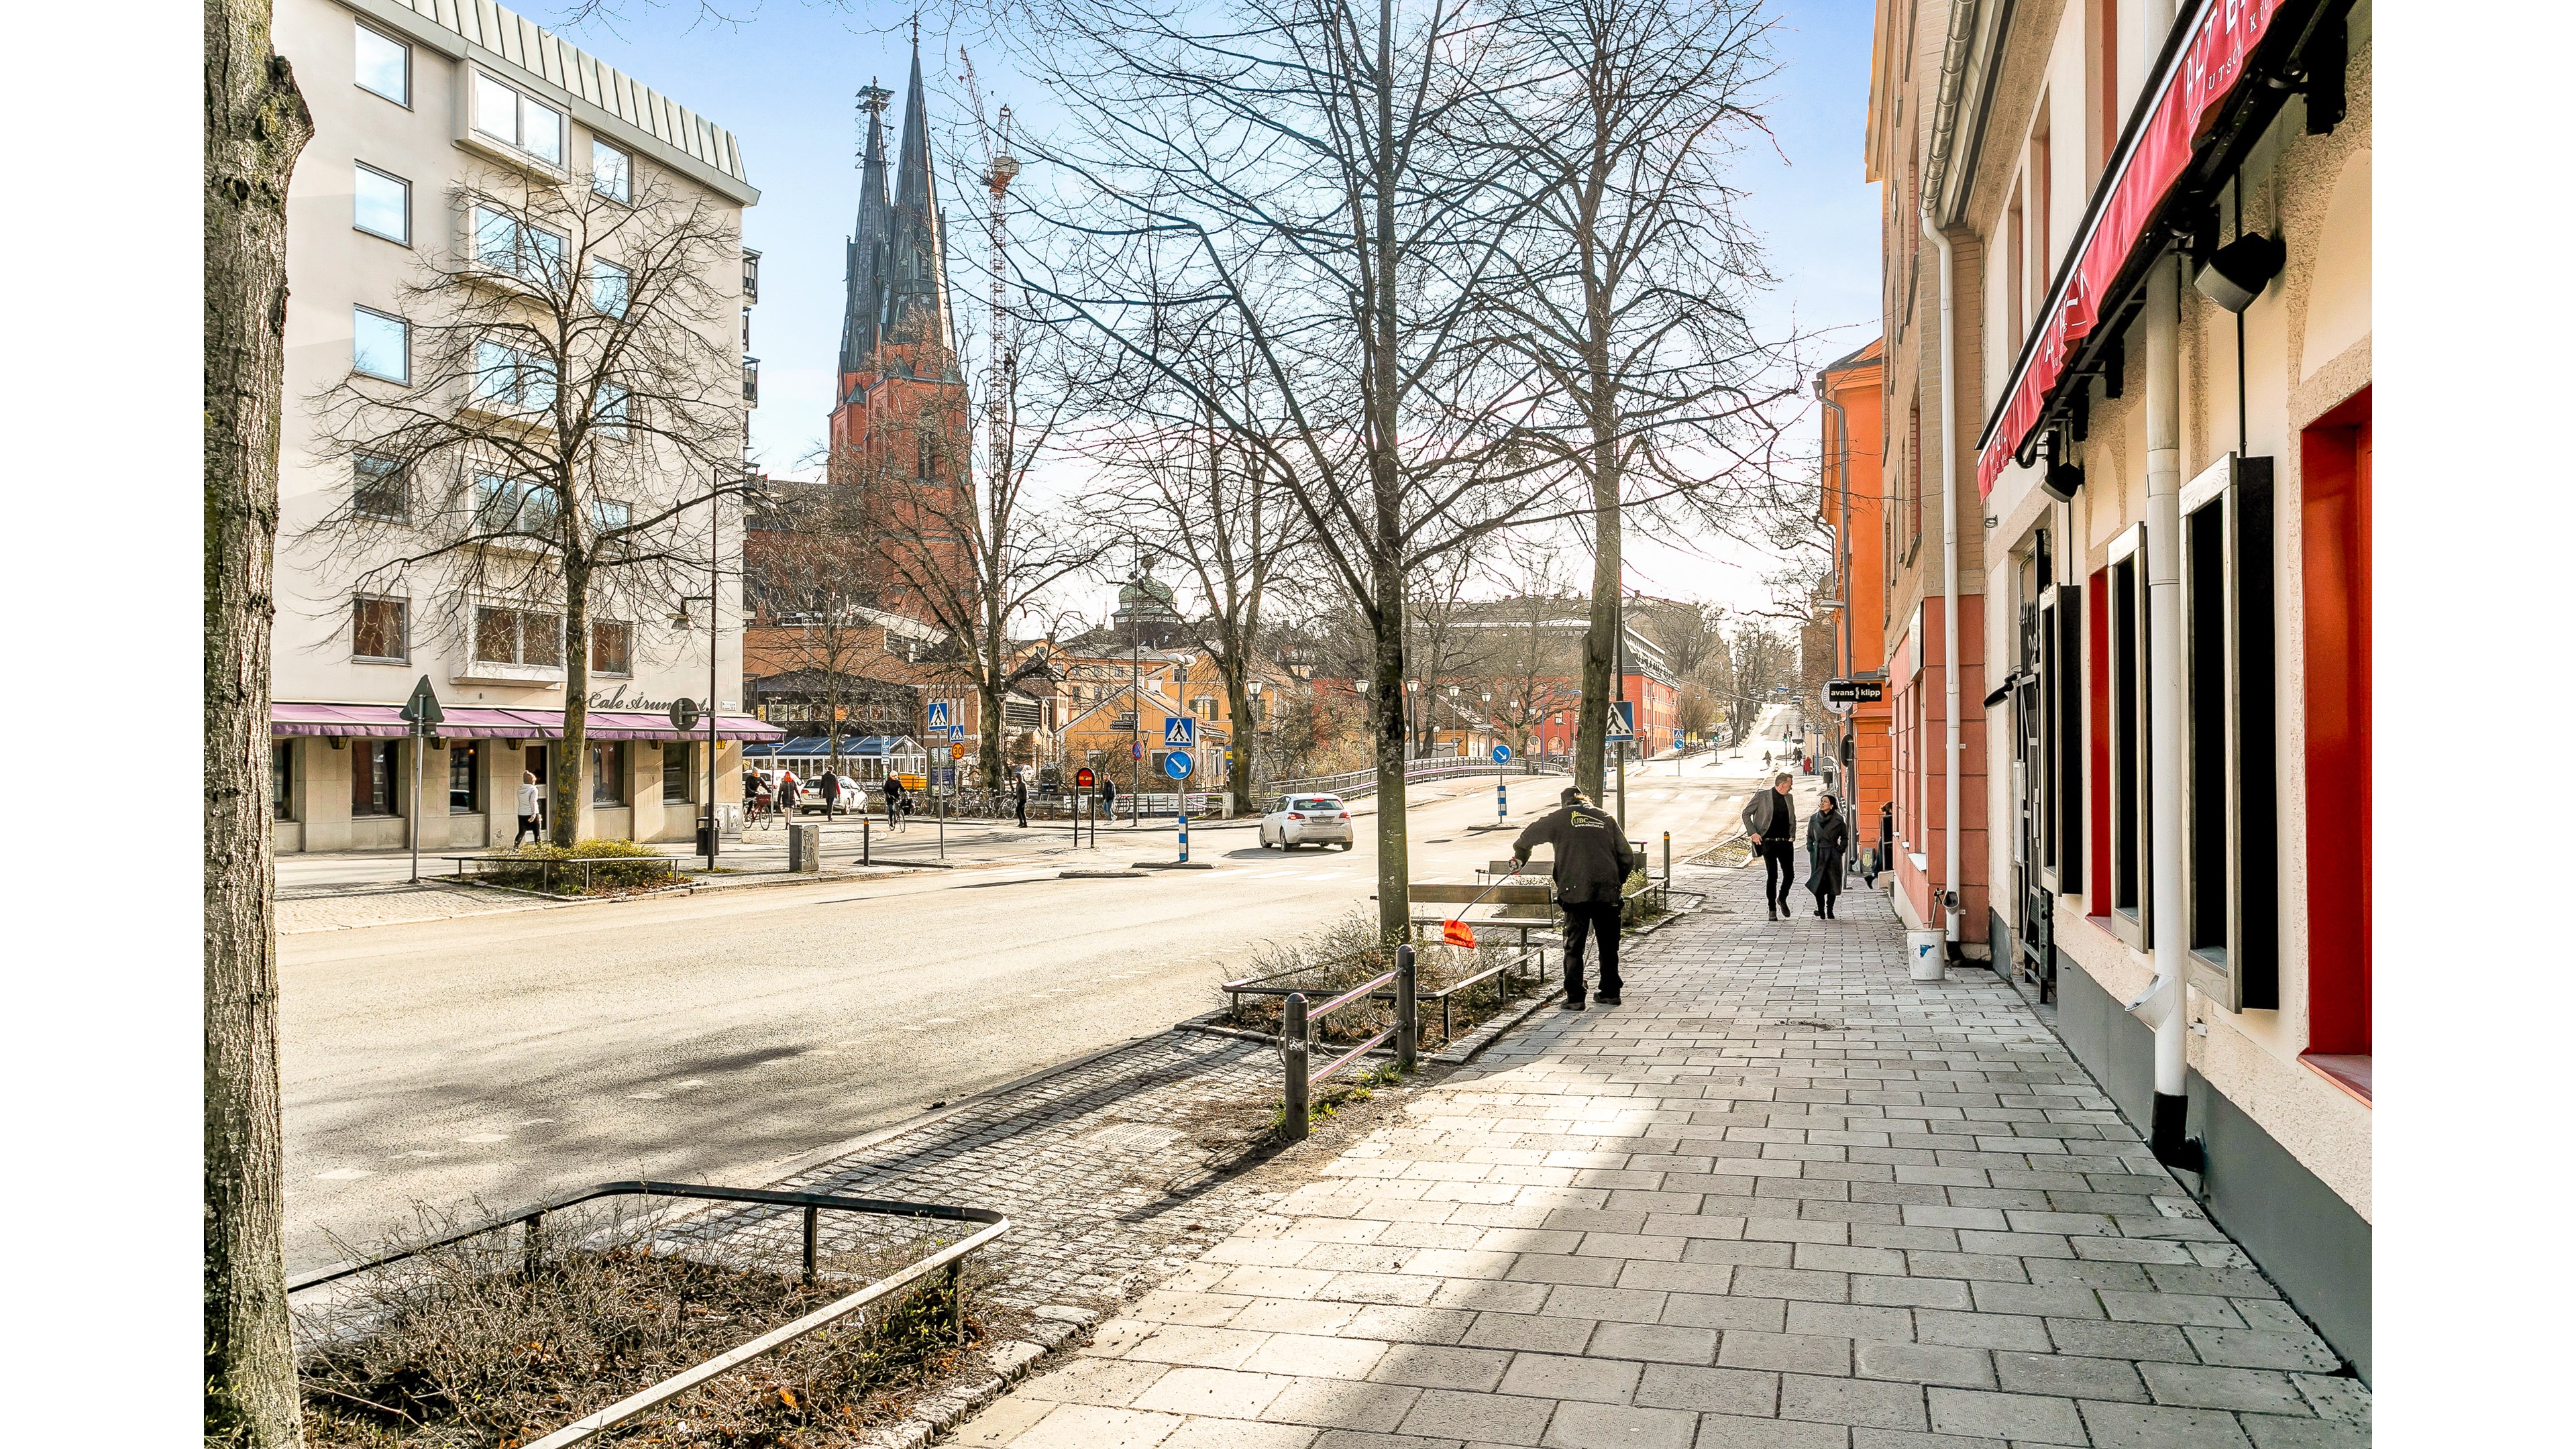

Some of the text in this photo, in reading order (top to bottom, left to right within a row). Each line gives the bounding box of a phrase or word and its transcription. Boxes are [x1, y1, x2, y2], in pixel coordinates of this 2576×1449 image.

[1860, 689, 1880, 697] klipp
[883, 737, 889, 745] P
[953, 747, 963, 755] 30
